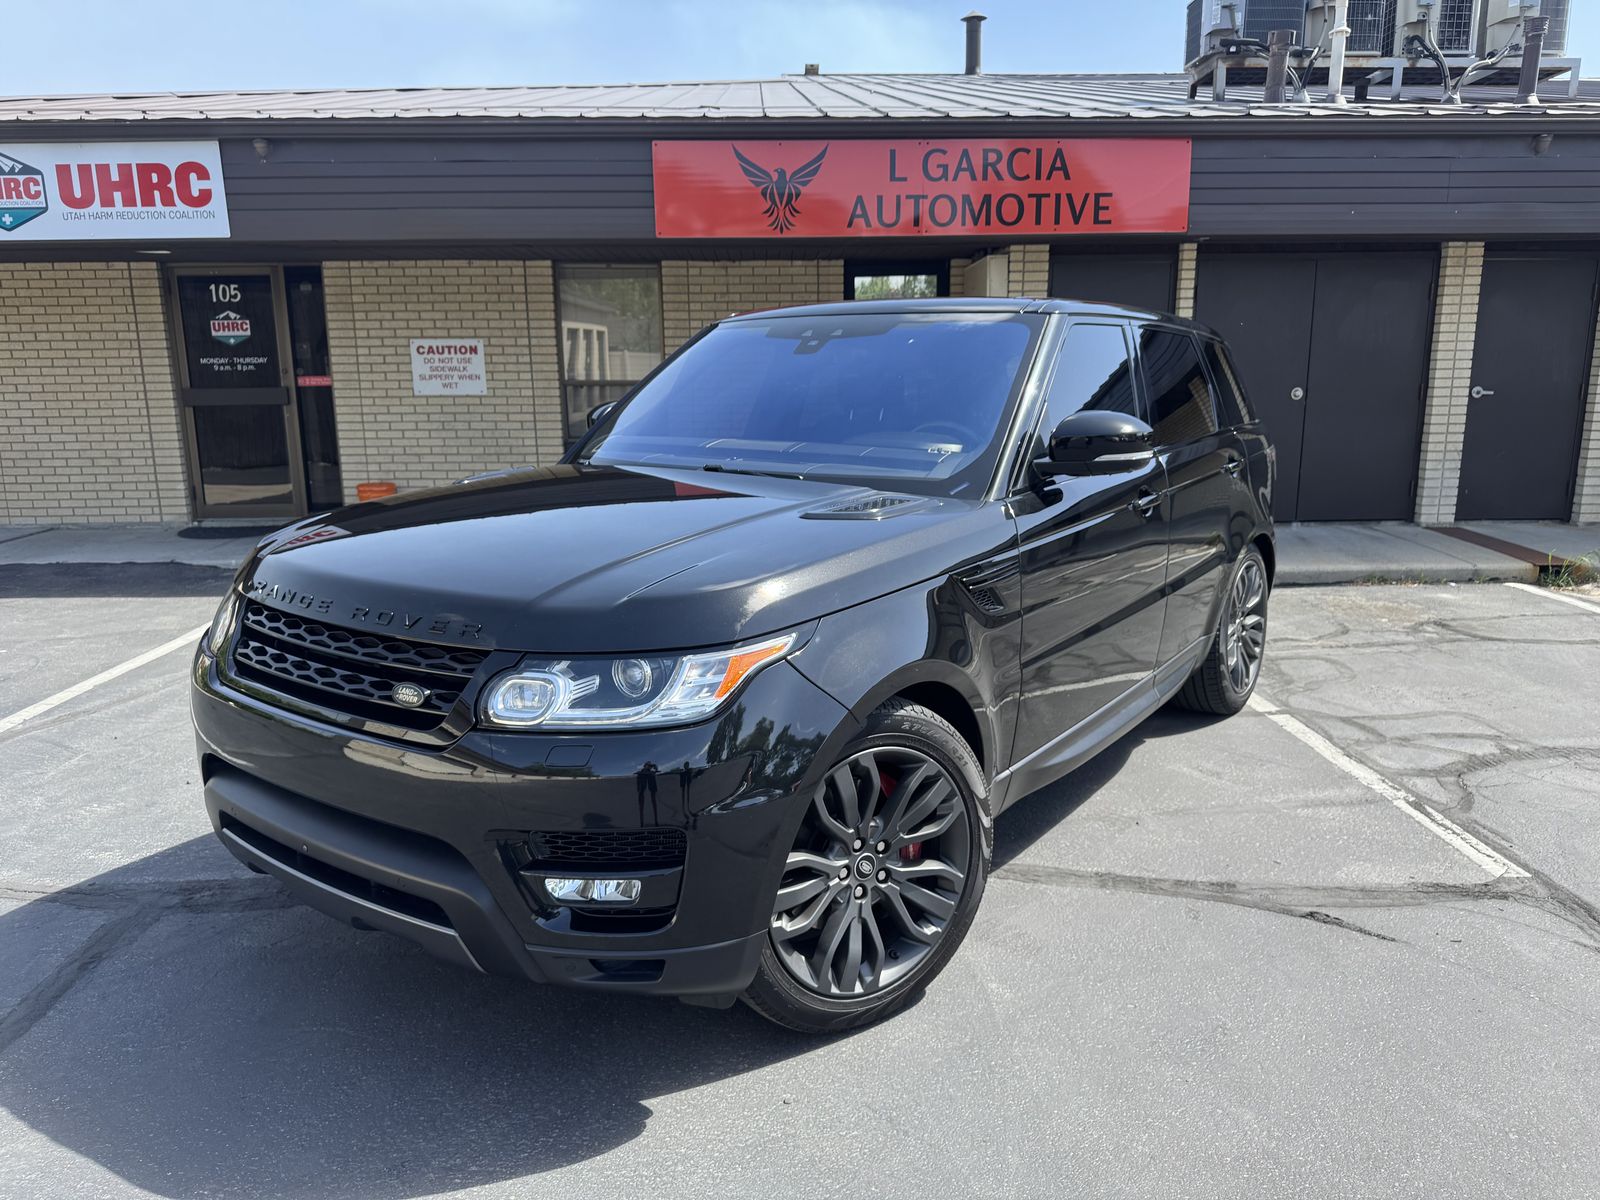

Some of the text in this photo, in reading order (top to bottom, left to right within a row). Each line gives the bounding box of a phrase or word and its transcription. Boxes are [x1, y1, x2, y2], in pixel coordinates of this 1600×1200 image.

[889, 147, 1071, 182] L GARCIA
[0, 176, 42, 200] RC
[55, 161, 212, 209] UHRC
[62, 210, 216, 221] UTAH HARM REDUCTION COALITION
[847, 193, 1112, 228] AUTOMOTIVE
[209, 284, 241, 302] 105
[212, 321, 249, 332] UHRC
[416, 345, 478, 355] CAUTION
[233, 356, 268, 364] THURSDAY
[423, 357, 435, 365] DO
[438, 357, 454, 365] NOT
[254, 581, 483, 639] RANGE ROVER
[399, 687, 415, 696] LAND
[399, 694, 418, 703] ROVER
